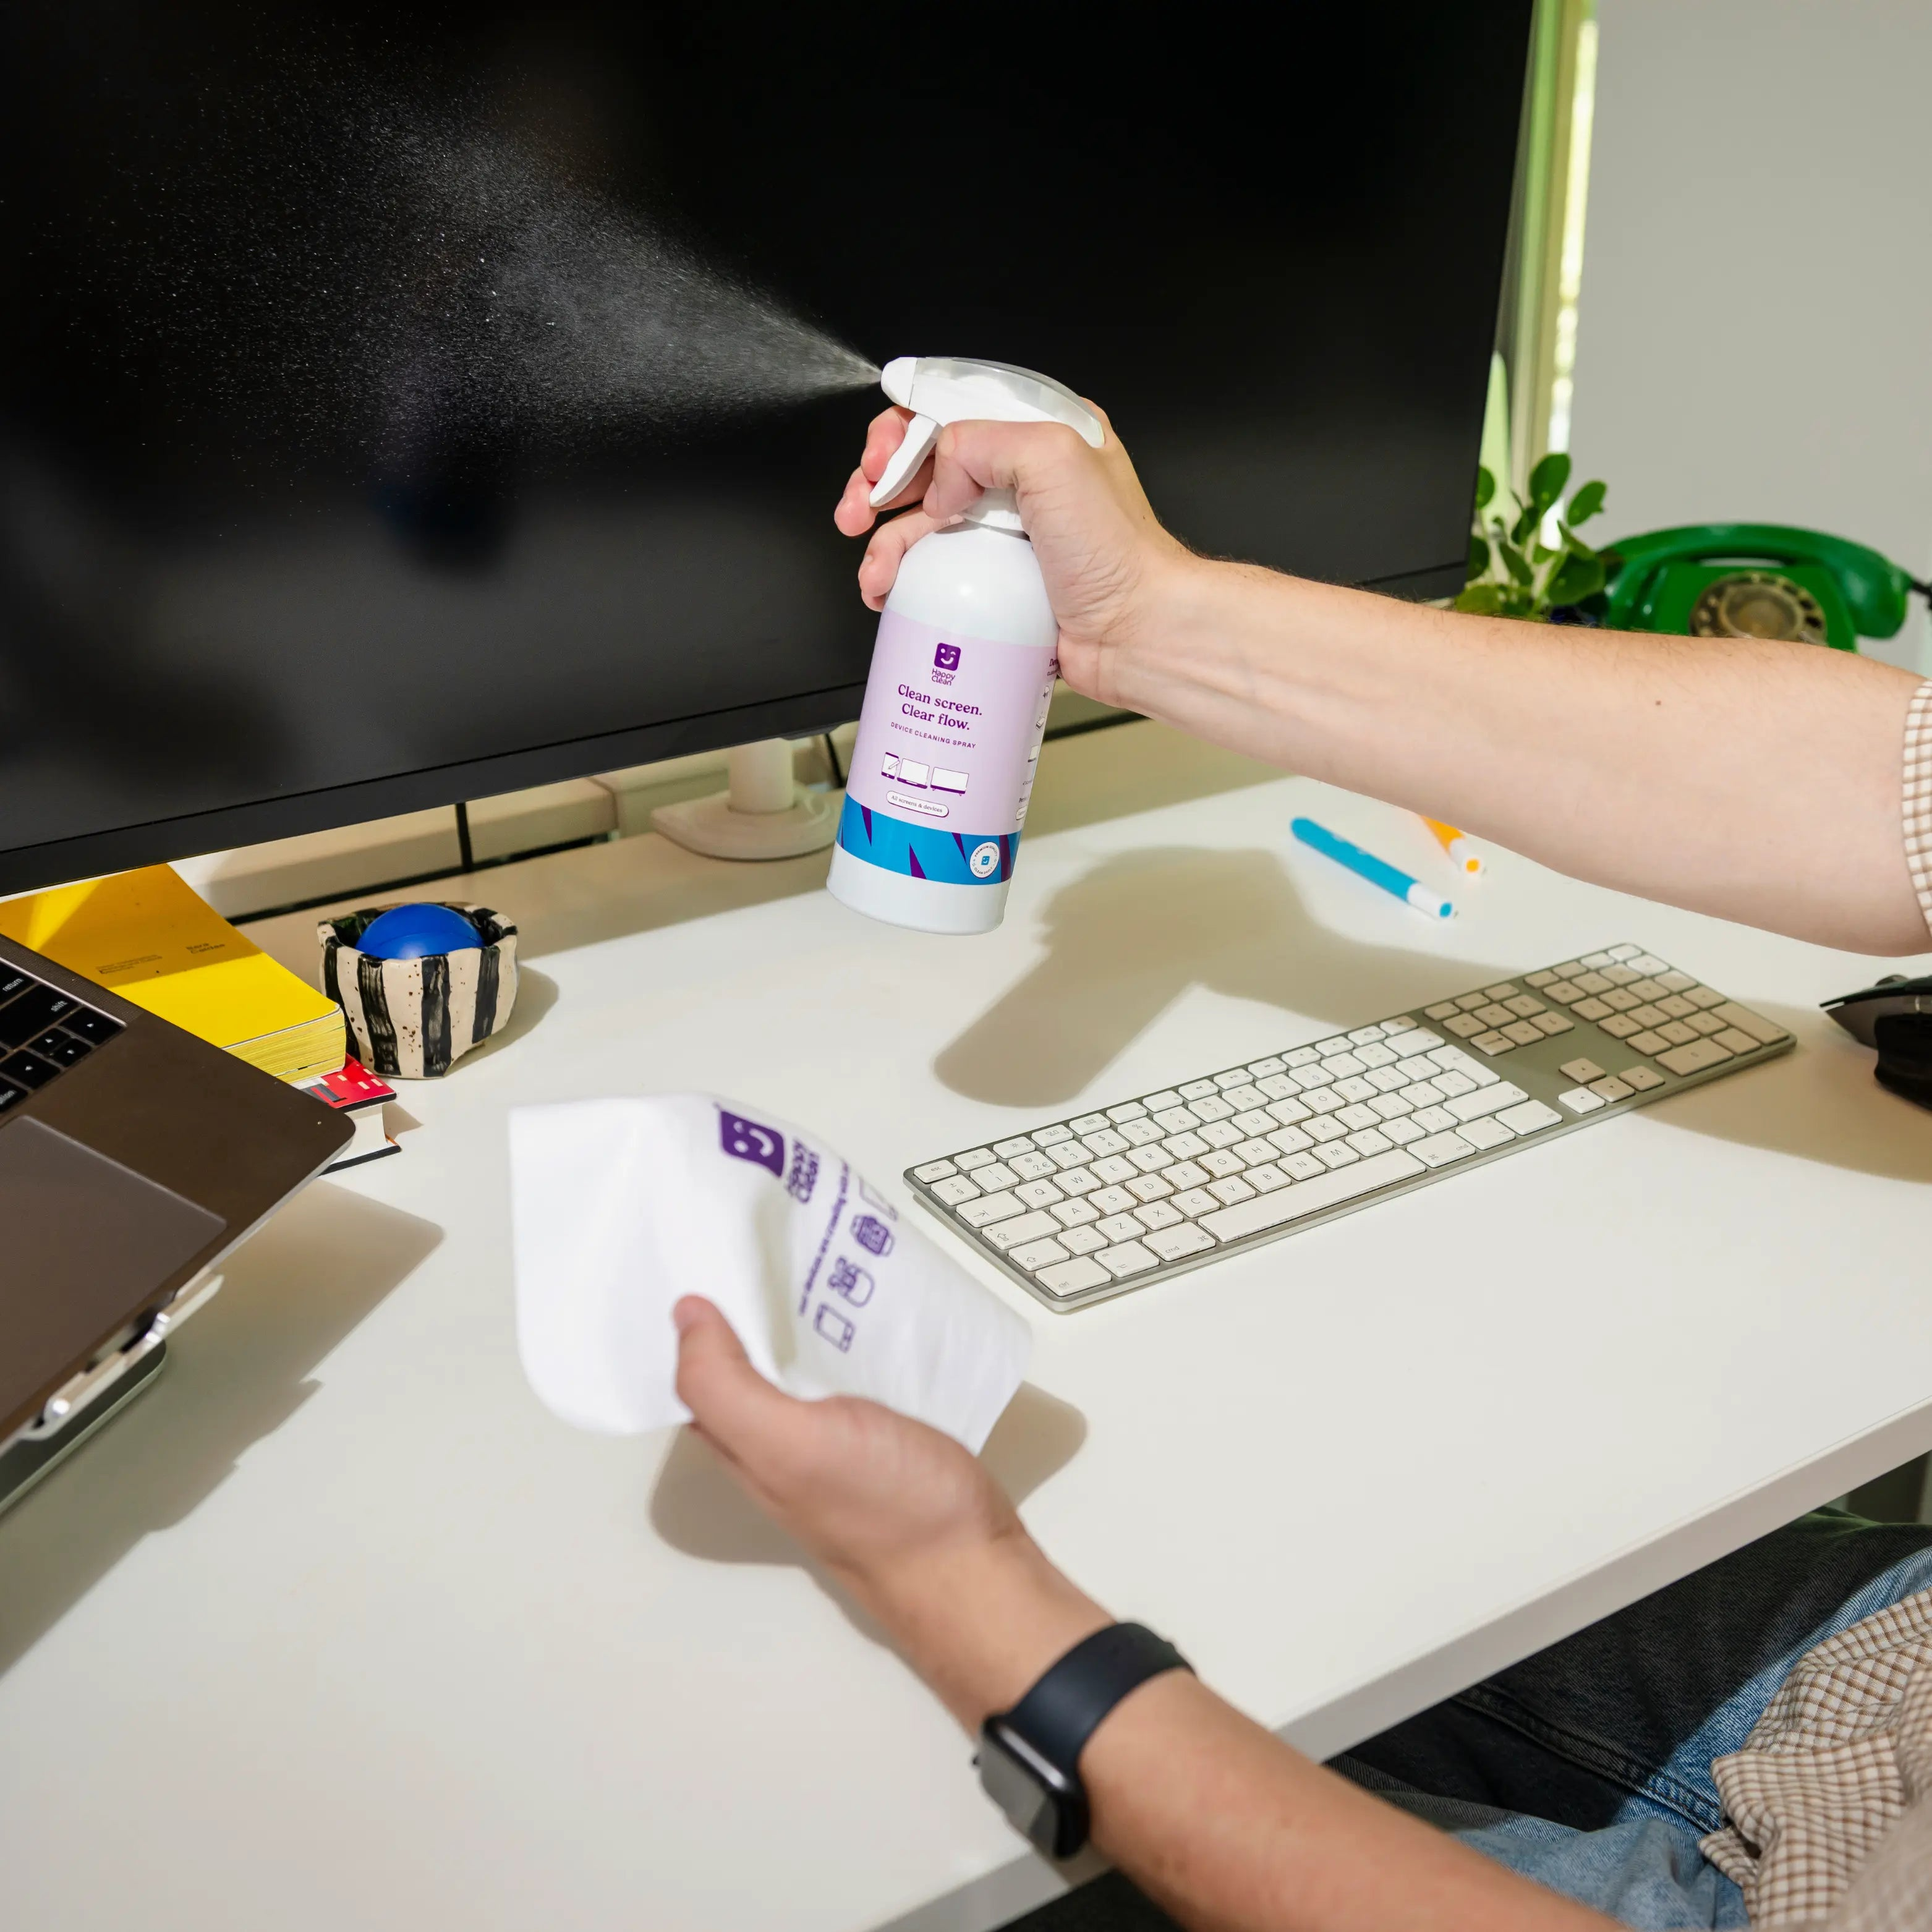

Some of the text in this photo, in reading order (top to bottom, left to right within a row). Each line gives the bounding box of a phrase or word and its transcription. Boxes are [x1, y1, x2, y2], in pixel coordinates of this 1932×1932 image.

[932, 668, 955, 681] Happy
[932, 675, 951, 686] Clean
[898, 684, 982, 715] Clean screen.
[902, 703, 969, 730] Clear flow.
[891, 721, 976, 749] DEVICE CLEANING SPRAY
[899, 798, 917, 807] screens
[923, 804, 942, 812] devices
[2, 978, 23, 992] return
[51, 1000, 68, 1012] shift
